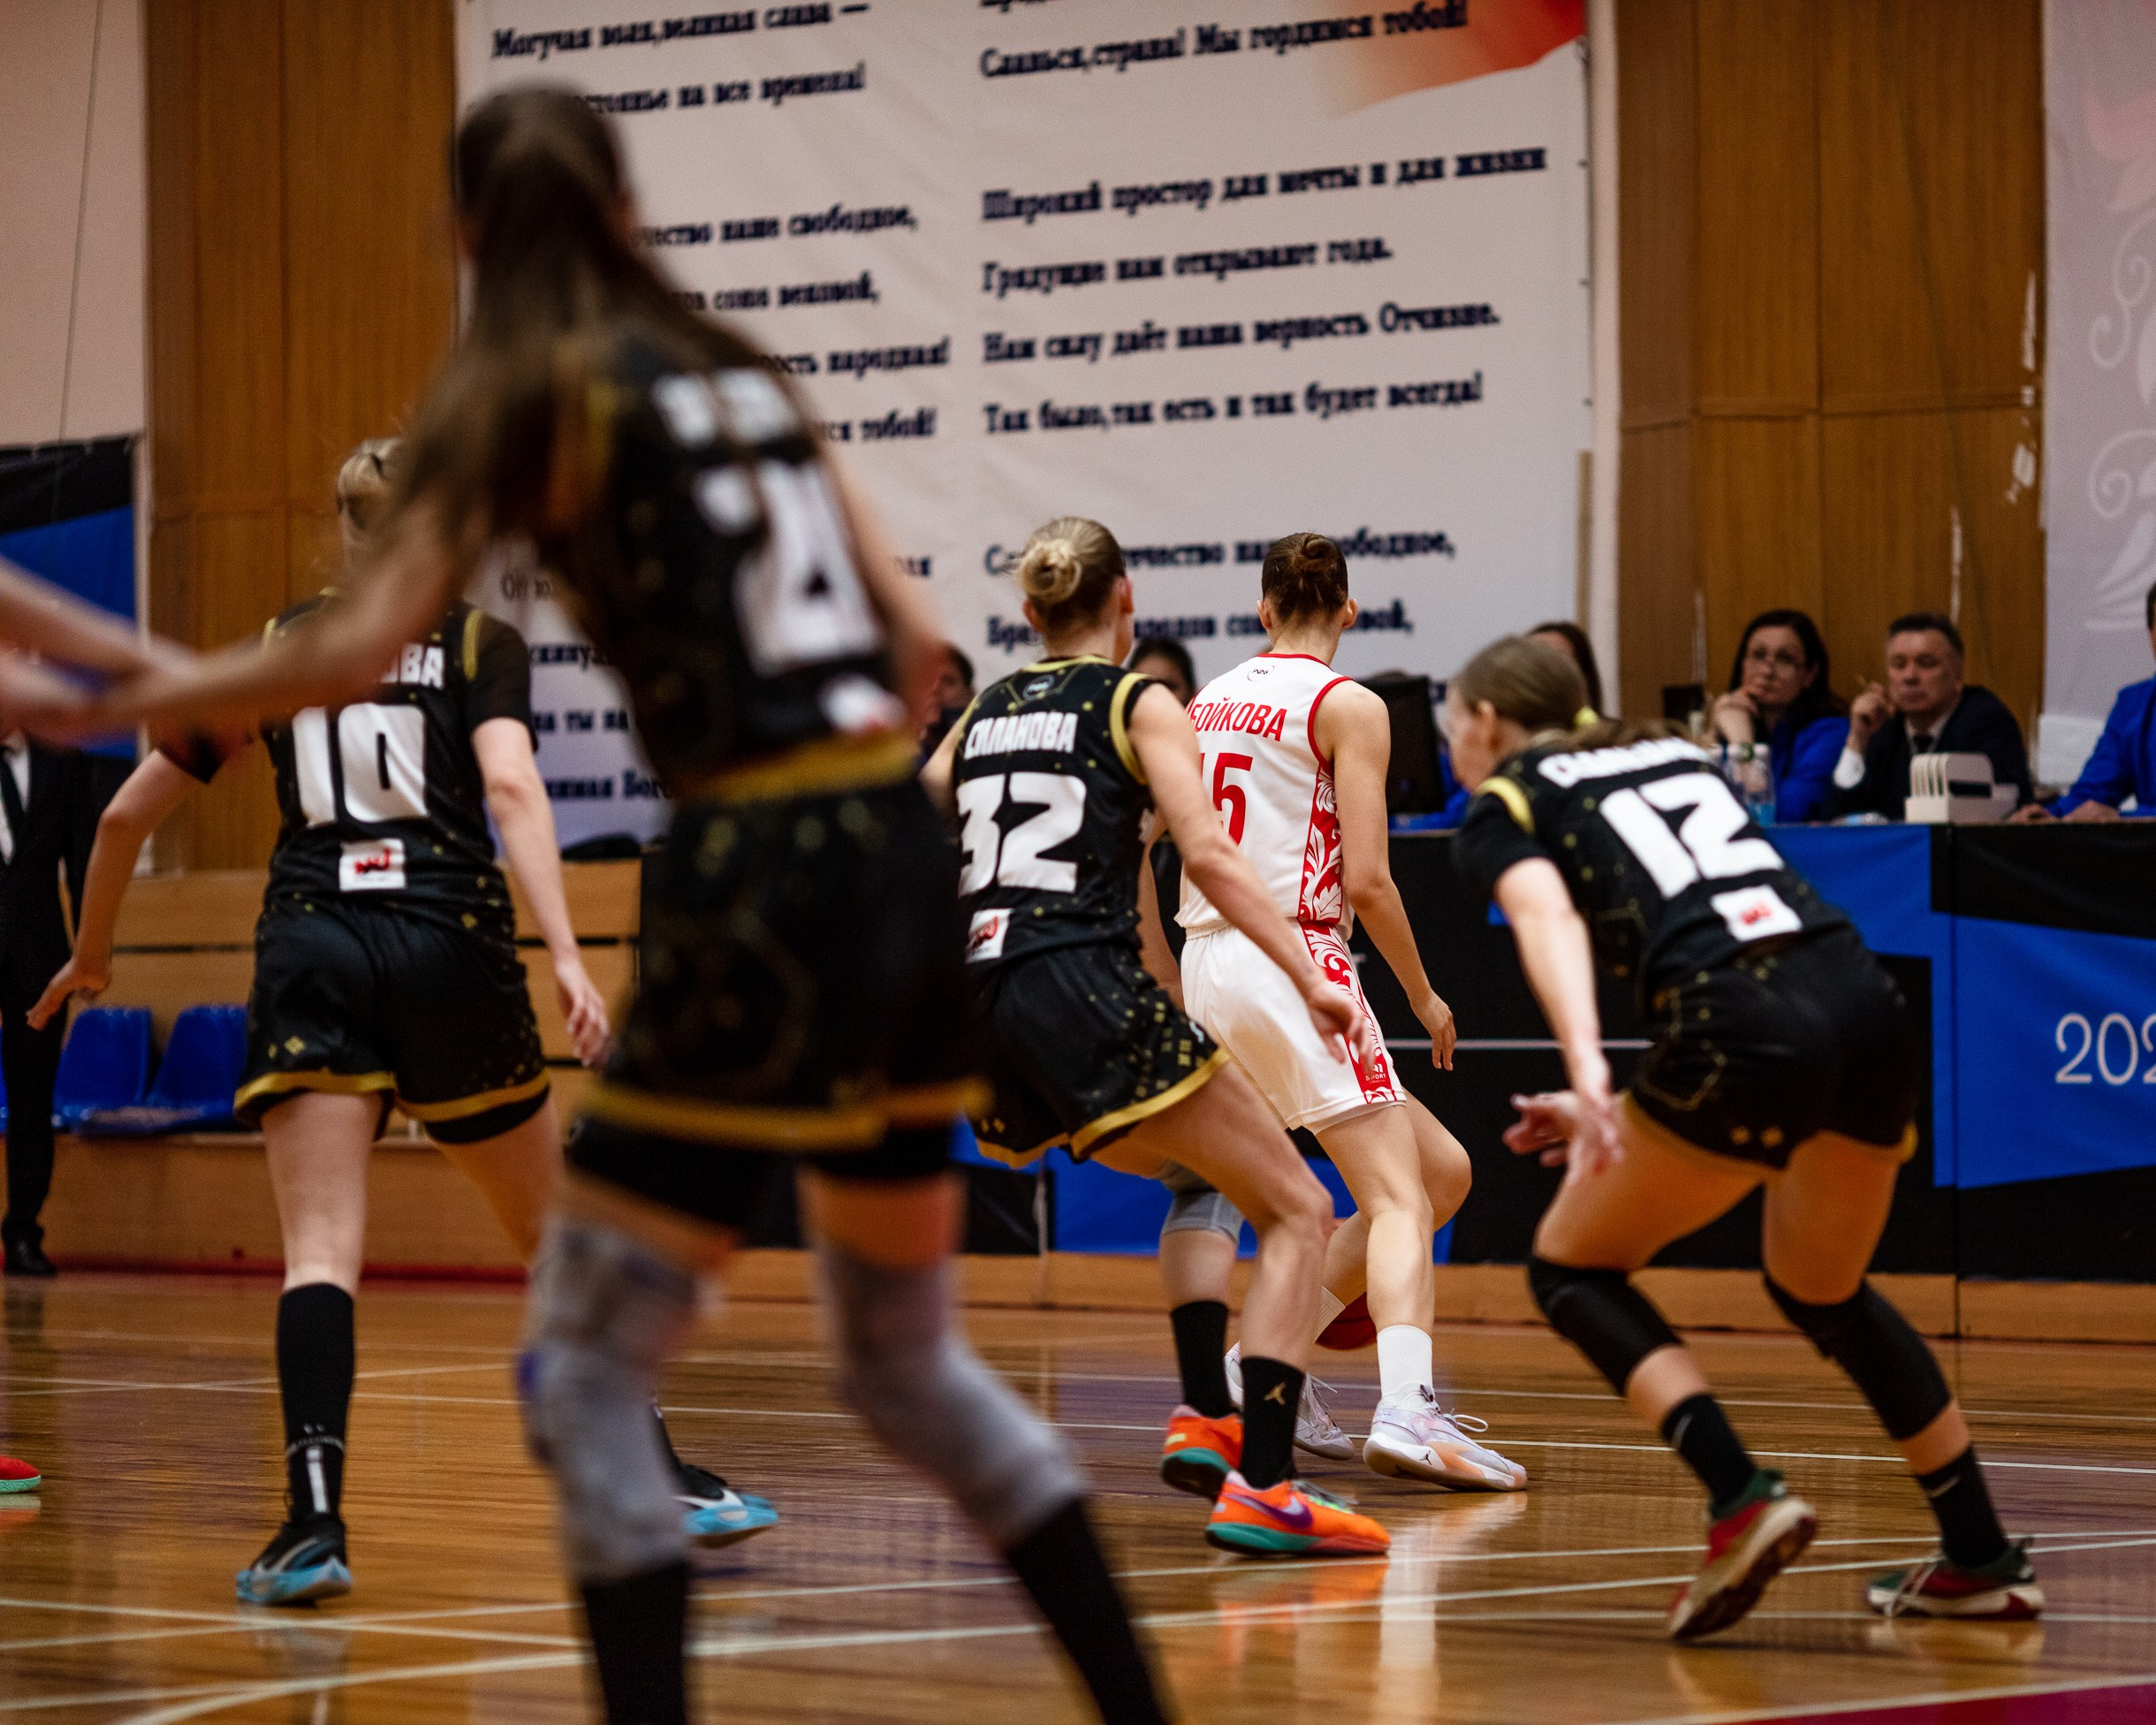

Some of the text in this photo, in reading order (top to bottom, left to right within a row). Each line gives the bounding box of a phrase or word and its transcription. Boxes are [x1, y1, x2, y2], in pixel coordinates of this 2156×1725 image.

[292, 703, 429, 828] 10
[1200, 752, 1253, 846] 5
[956, 771, 1086, 898] 32
[1599, 771, 1784, 900] 12
